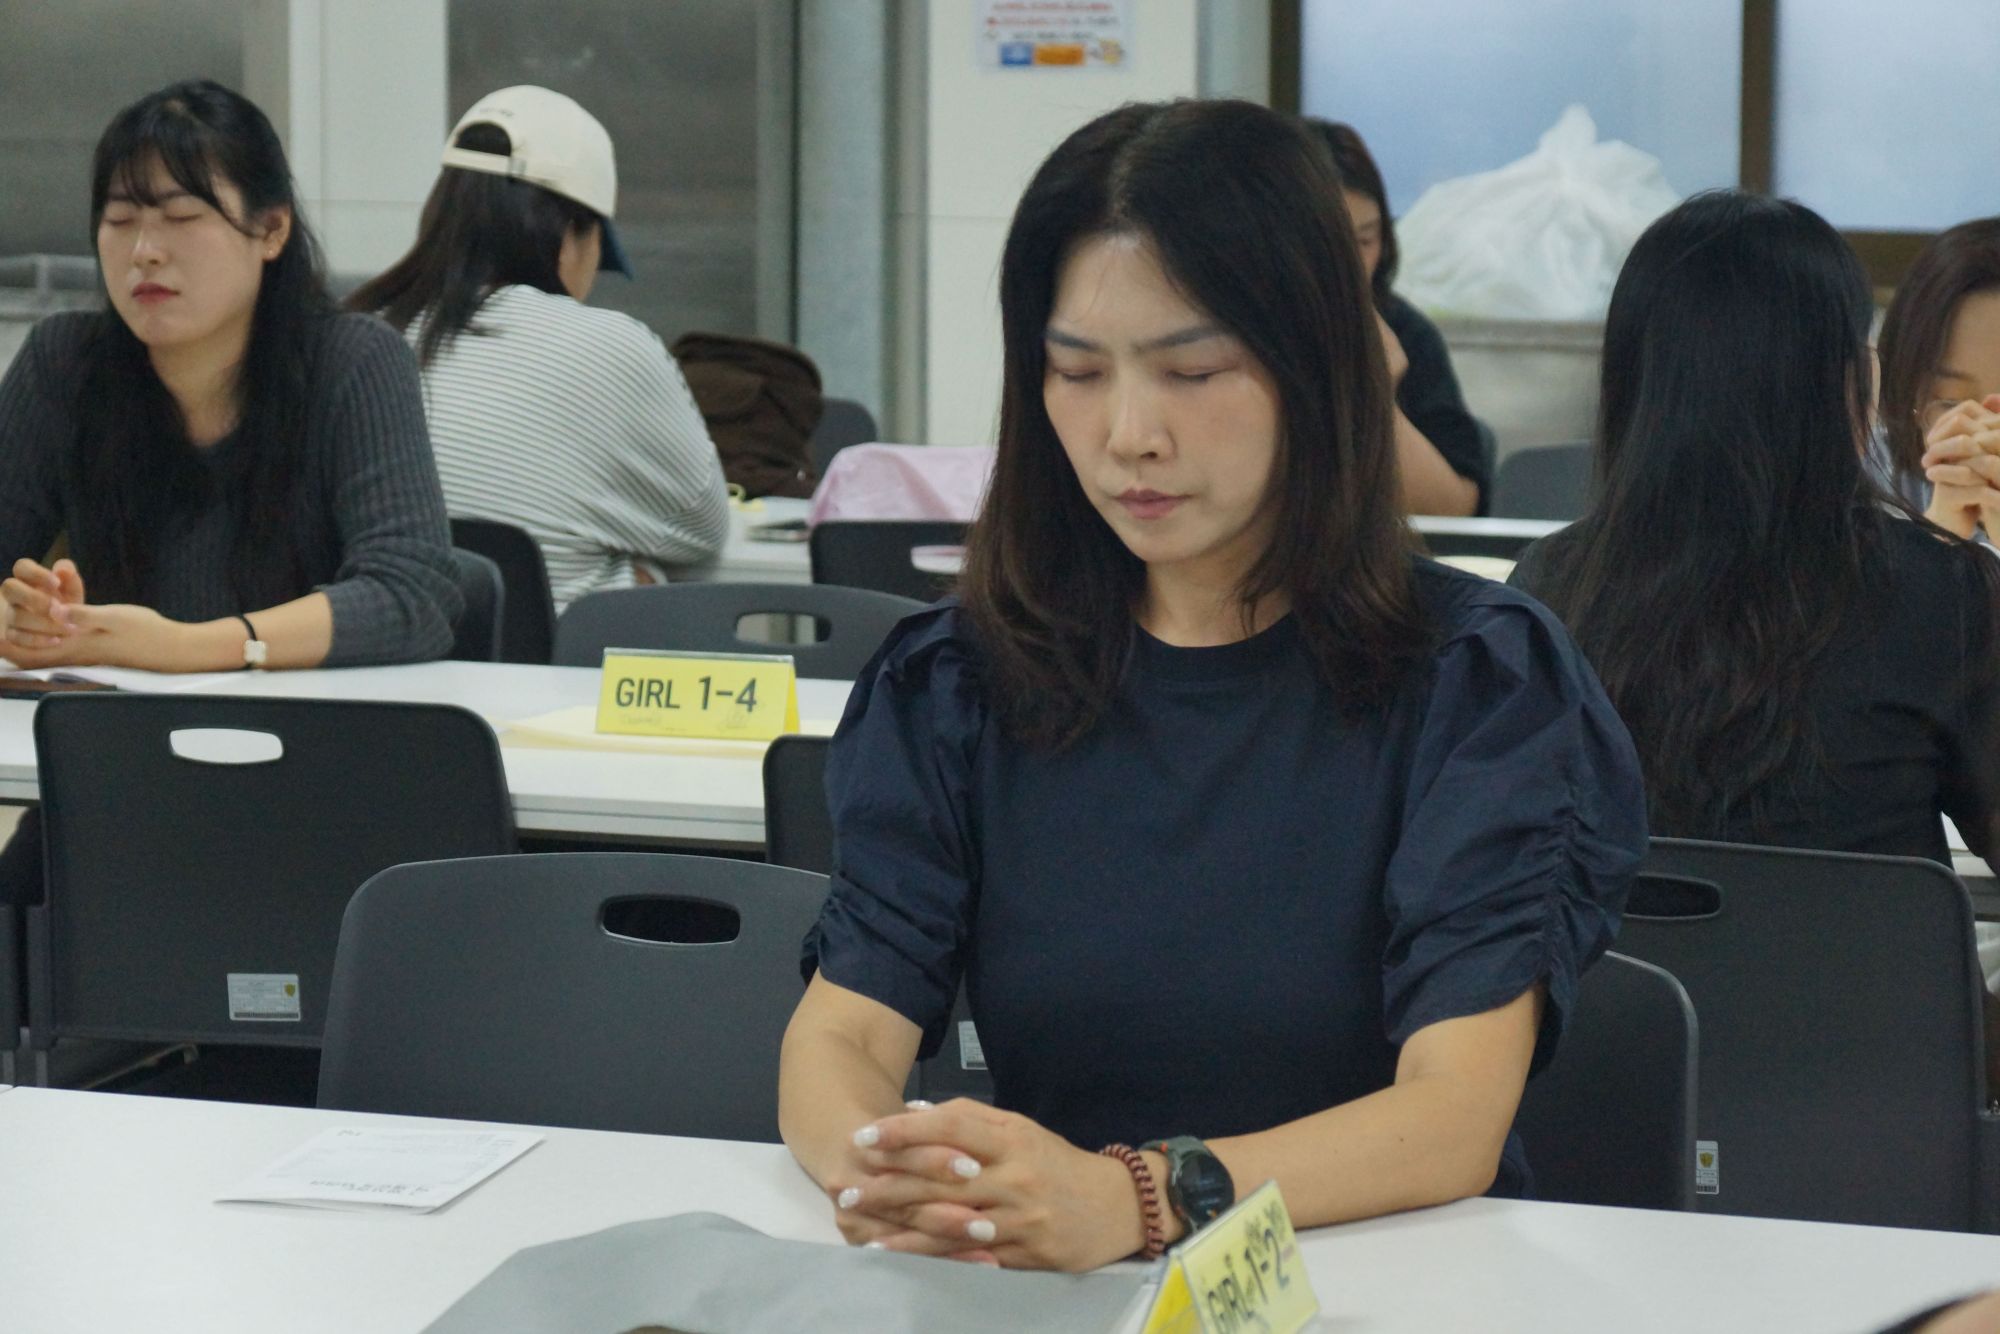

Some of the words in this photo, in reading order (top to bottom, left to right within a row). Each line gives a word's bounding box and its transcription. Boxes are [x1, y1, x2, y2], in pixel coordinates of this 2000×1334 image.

[615, 677, 681, 709] GIRL
[698, 675, 758, 713] 1-4
[1243, 1228, 1291, 1305] 1-2
